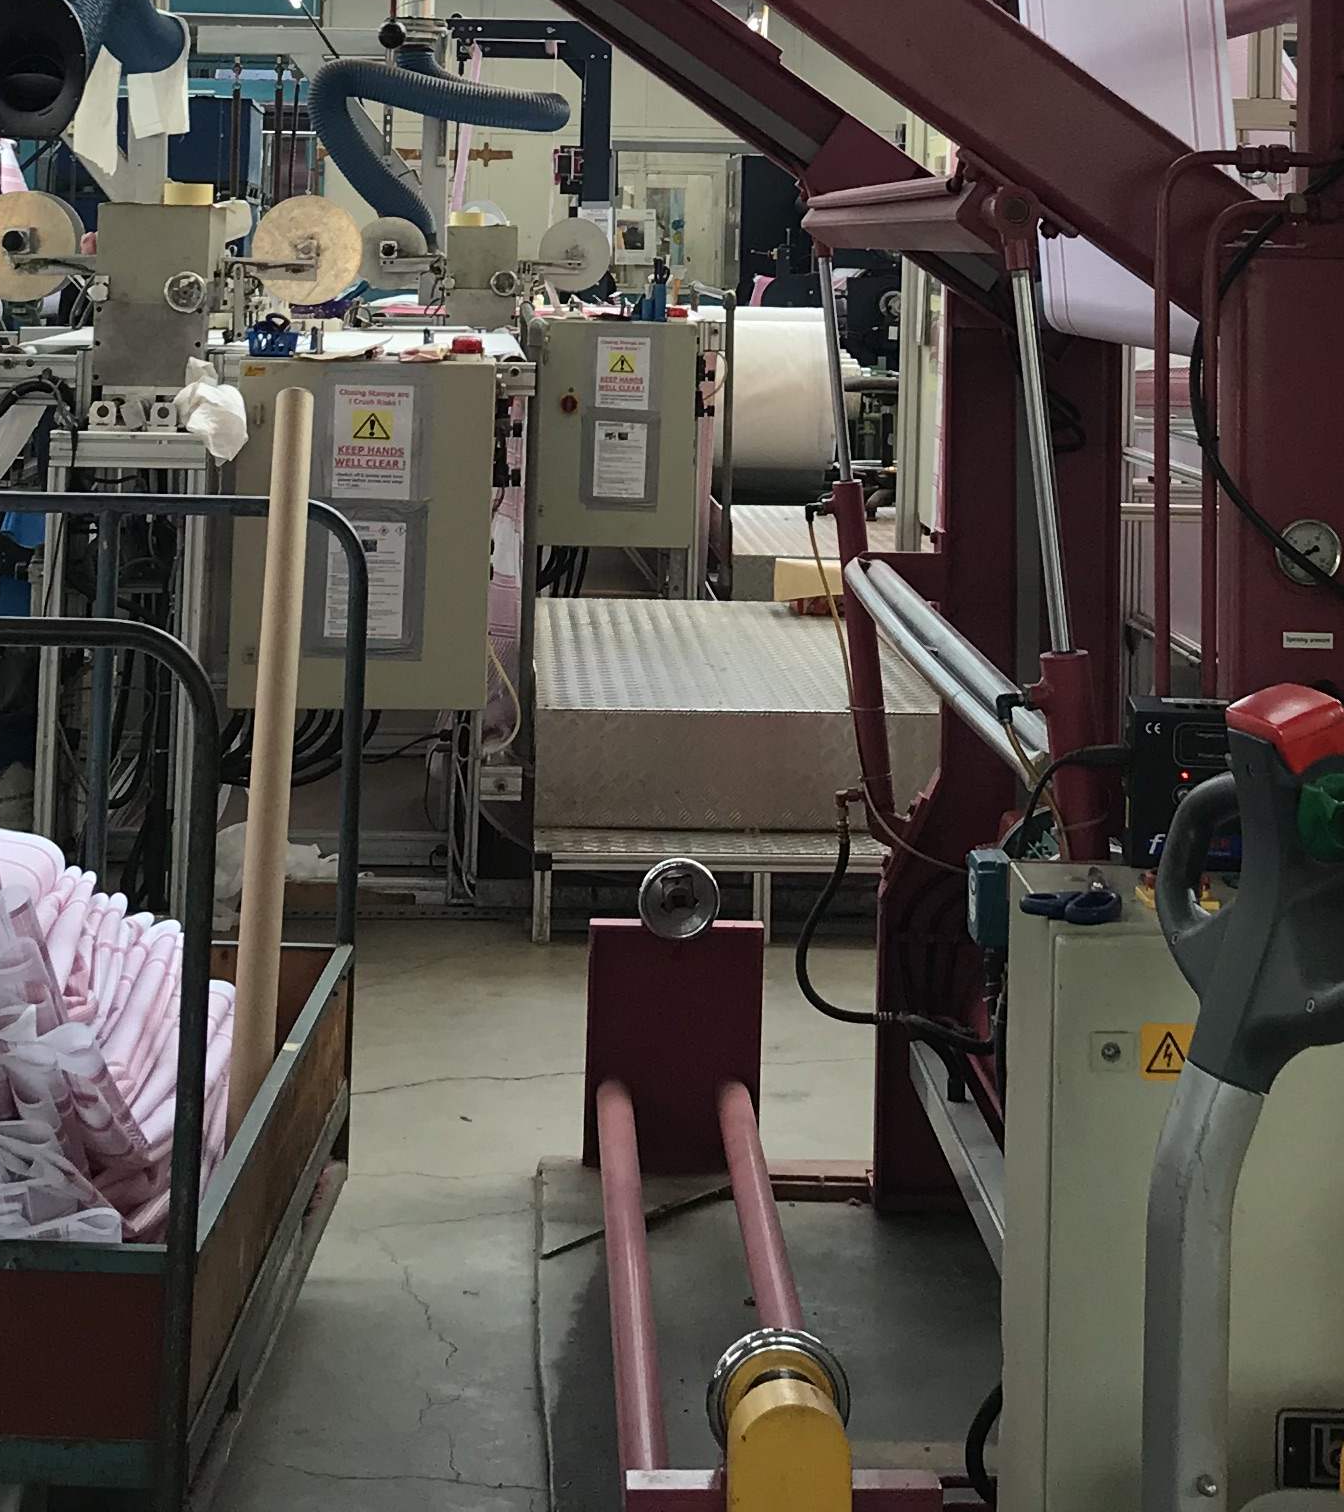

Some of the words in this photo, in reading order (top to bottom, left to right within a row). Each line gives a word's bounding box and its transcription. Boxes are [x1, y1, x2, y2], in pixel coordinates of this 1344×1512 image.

[337, 445, 364, 456] KEEP
[367, 446, 404, 457] HANDS
[334, 457, 363, 468] WELL
[366, 459, 400, 469] CLEAR
